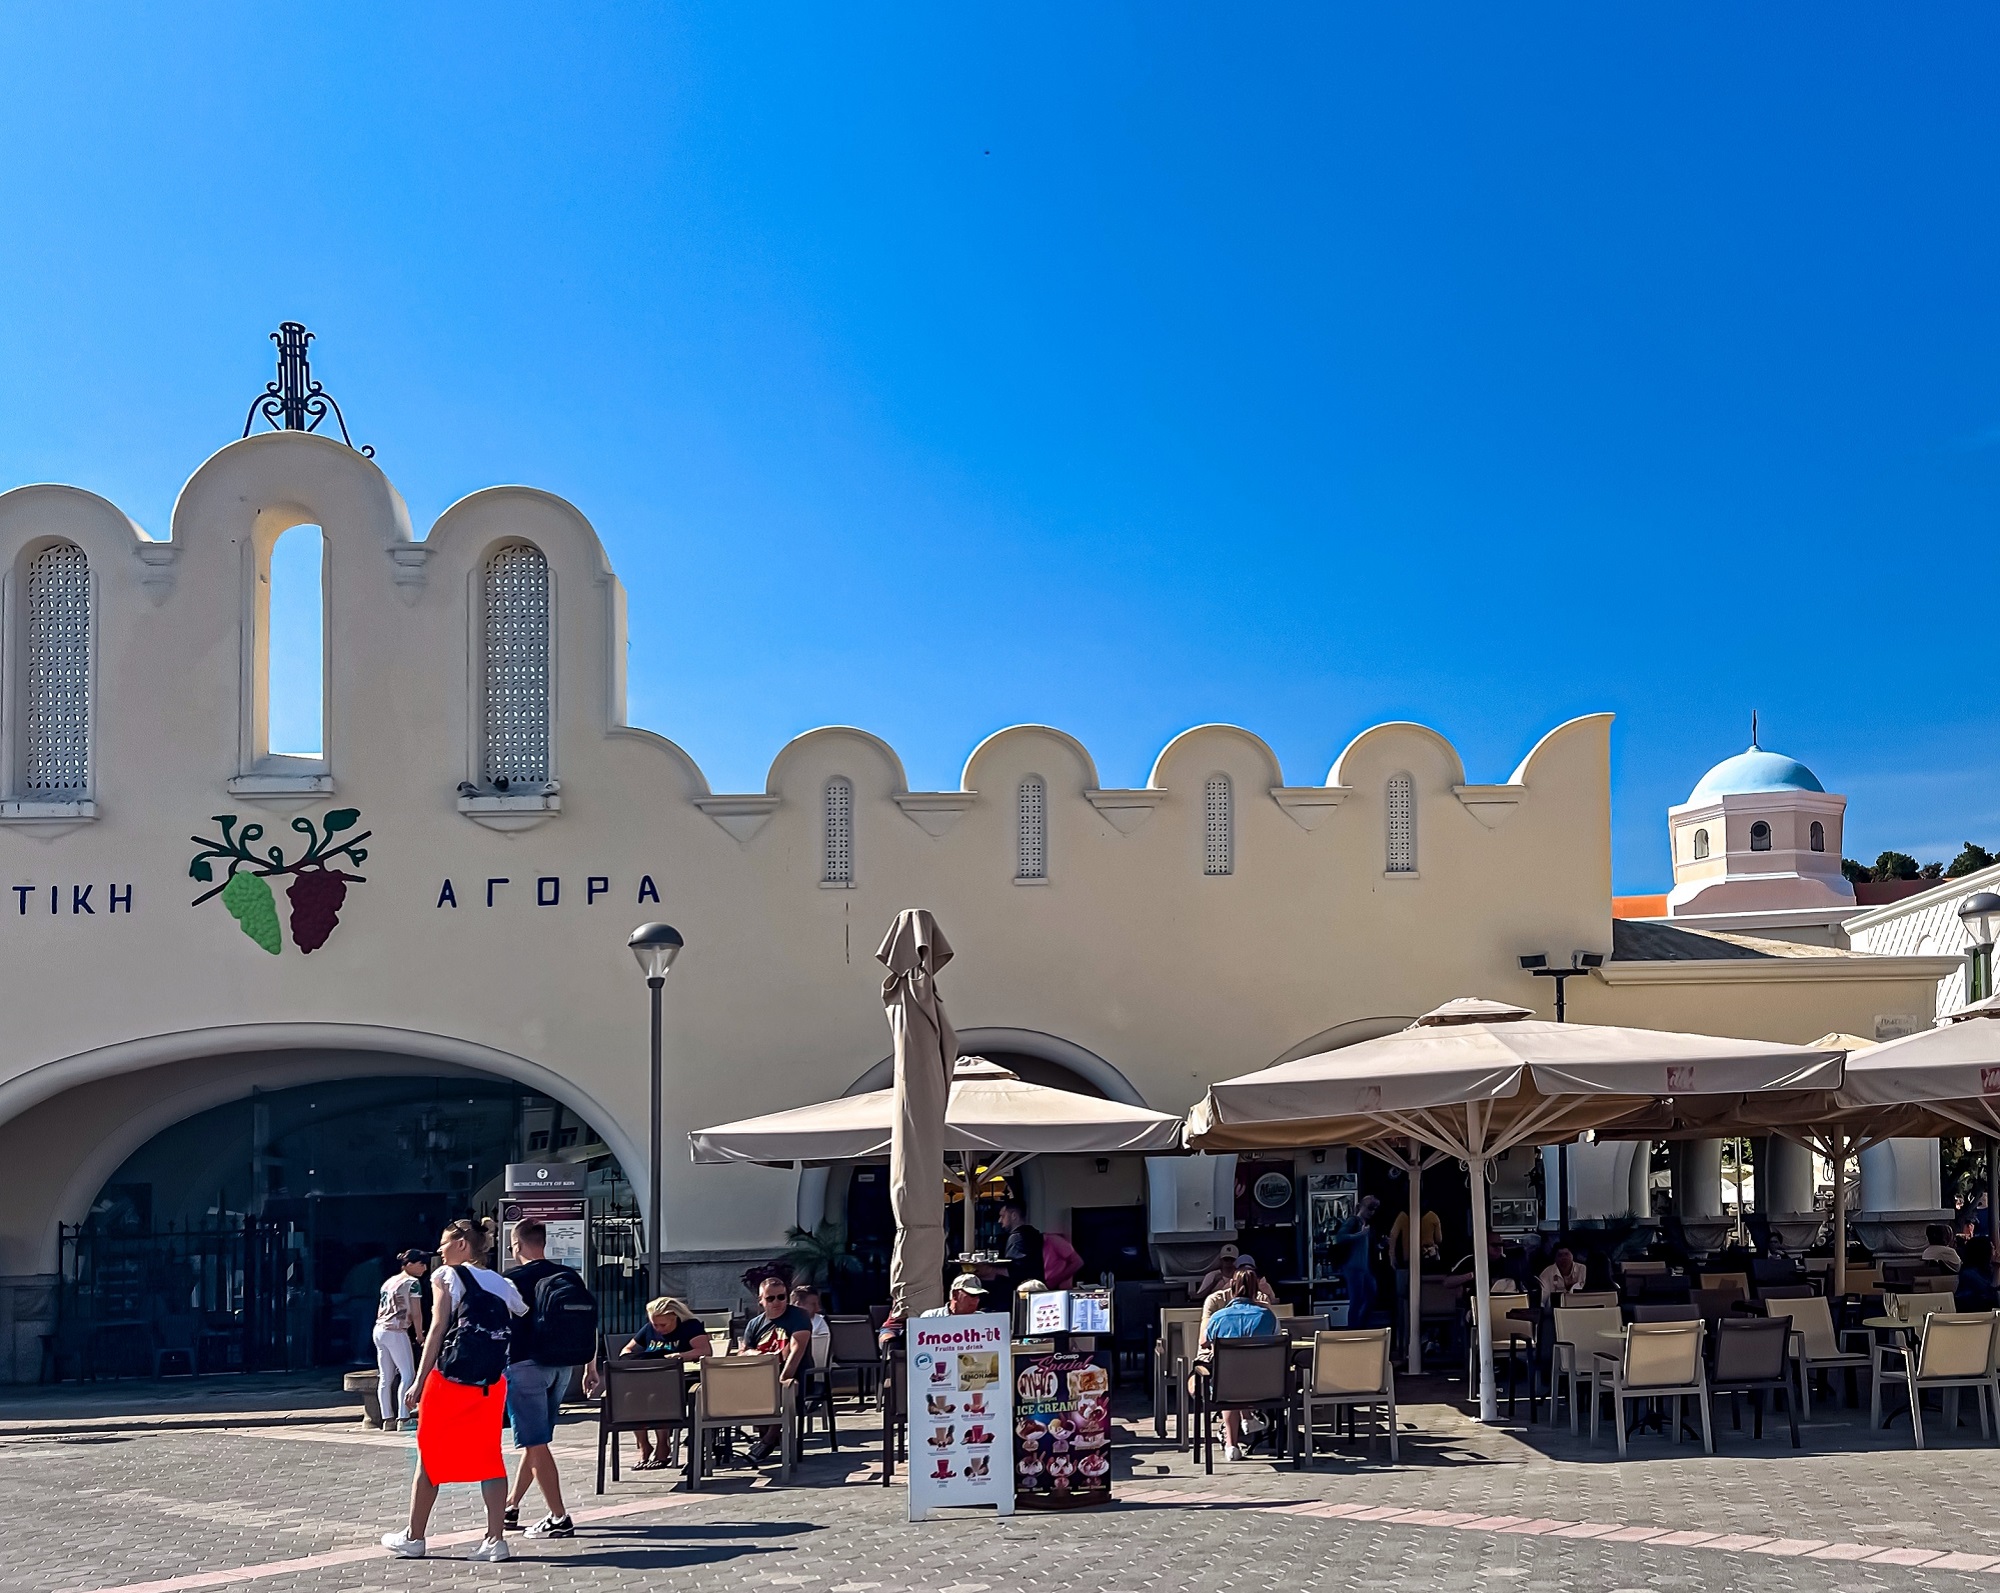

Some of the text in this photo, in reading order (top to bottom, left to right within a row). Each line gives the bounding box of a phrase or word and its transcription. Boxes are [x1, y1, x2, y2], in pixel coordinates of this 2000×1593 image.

[12, 875, 661, 915] ΤΙΚΗ ΑΓΟΡΑ
[1016, 1401, 1079, 1416] ICE CREAM
